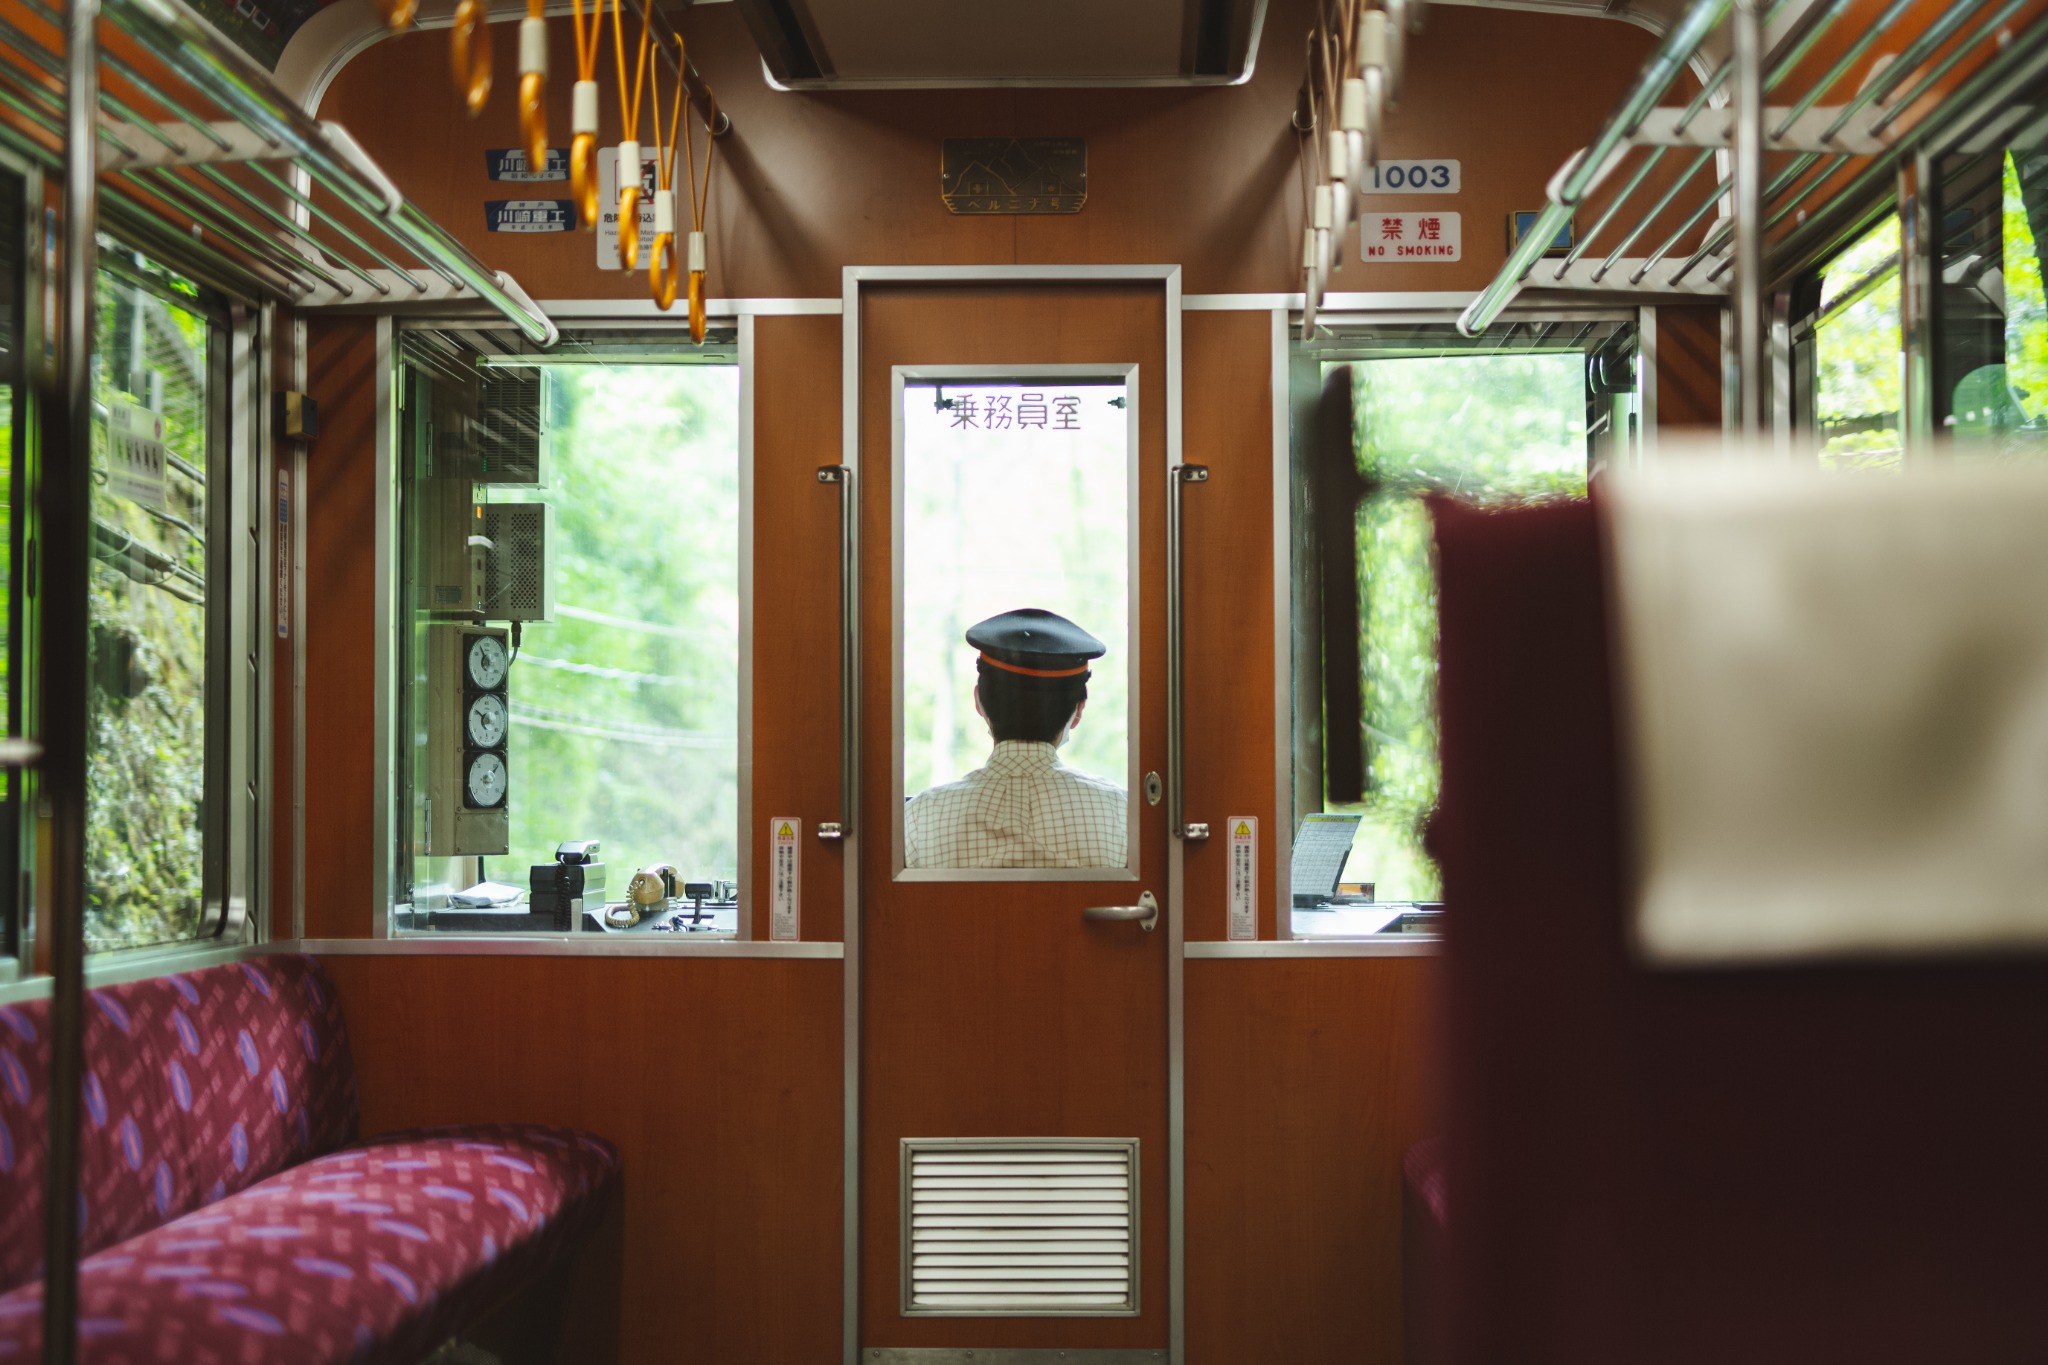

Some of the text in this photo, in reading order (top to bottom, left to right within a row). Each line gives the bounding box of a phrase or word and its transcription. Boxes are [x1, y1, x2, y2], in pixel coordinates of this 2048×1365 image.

[1374, 165, 1450, 188] 1003
[968, 198, 1061, 211] ベルニナ号
[497, 210, 565, 223] 川崎重工
[1382, 217, 1440, 240] 禁煙
[1368, 245, 1454, 256] NO SMOKING
[950, 393, 1081, 430] 乗務員室
